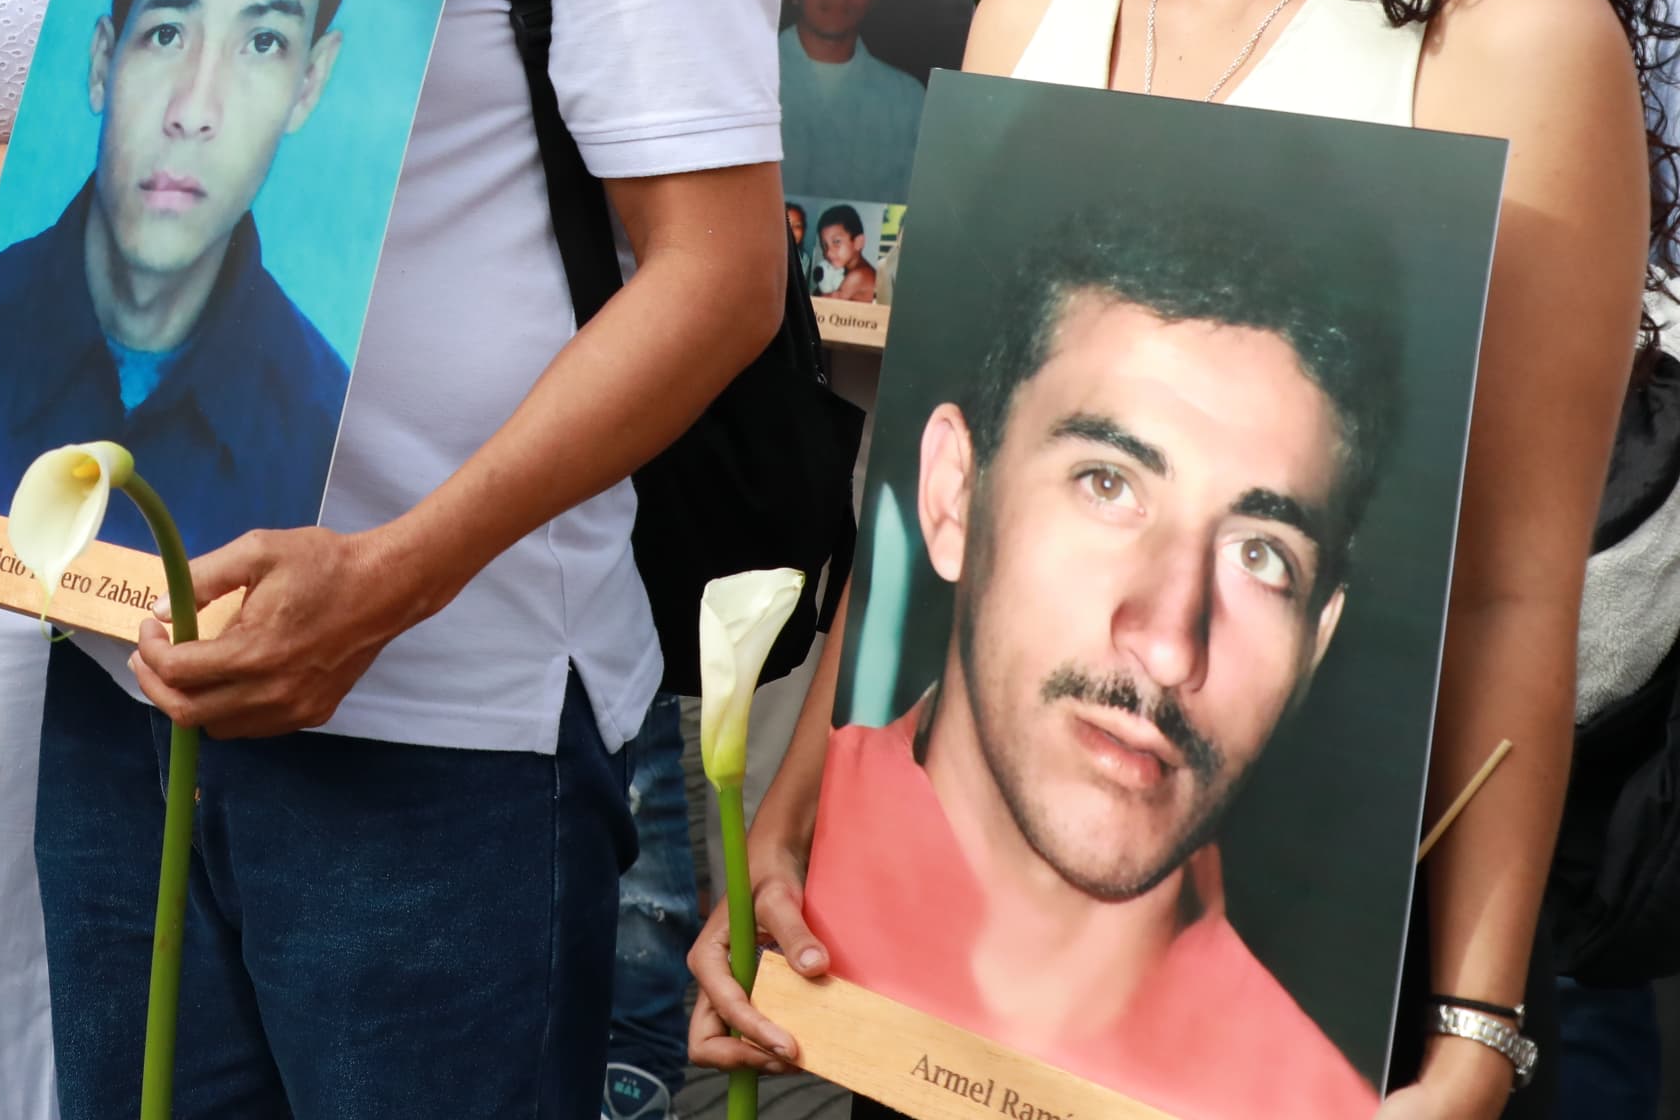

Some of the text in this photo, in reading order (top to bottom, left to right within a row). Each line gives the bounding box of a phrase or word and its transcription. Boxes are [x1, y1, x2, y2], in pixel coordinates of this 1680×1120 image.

[828, 313, 878, 330] Quitora
[96, 575, 160, 612] Zabala
[910, 1053, 1074, 1120] Armel Ra
